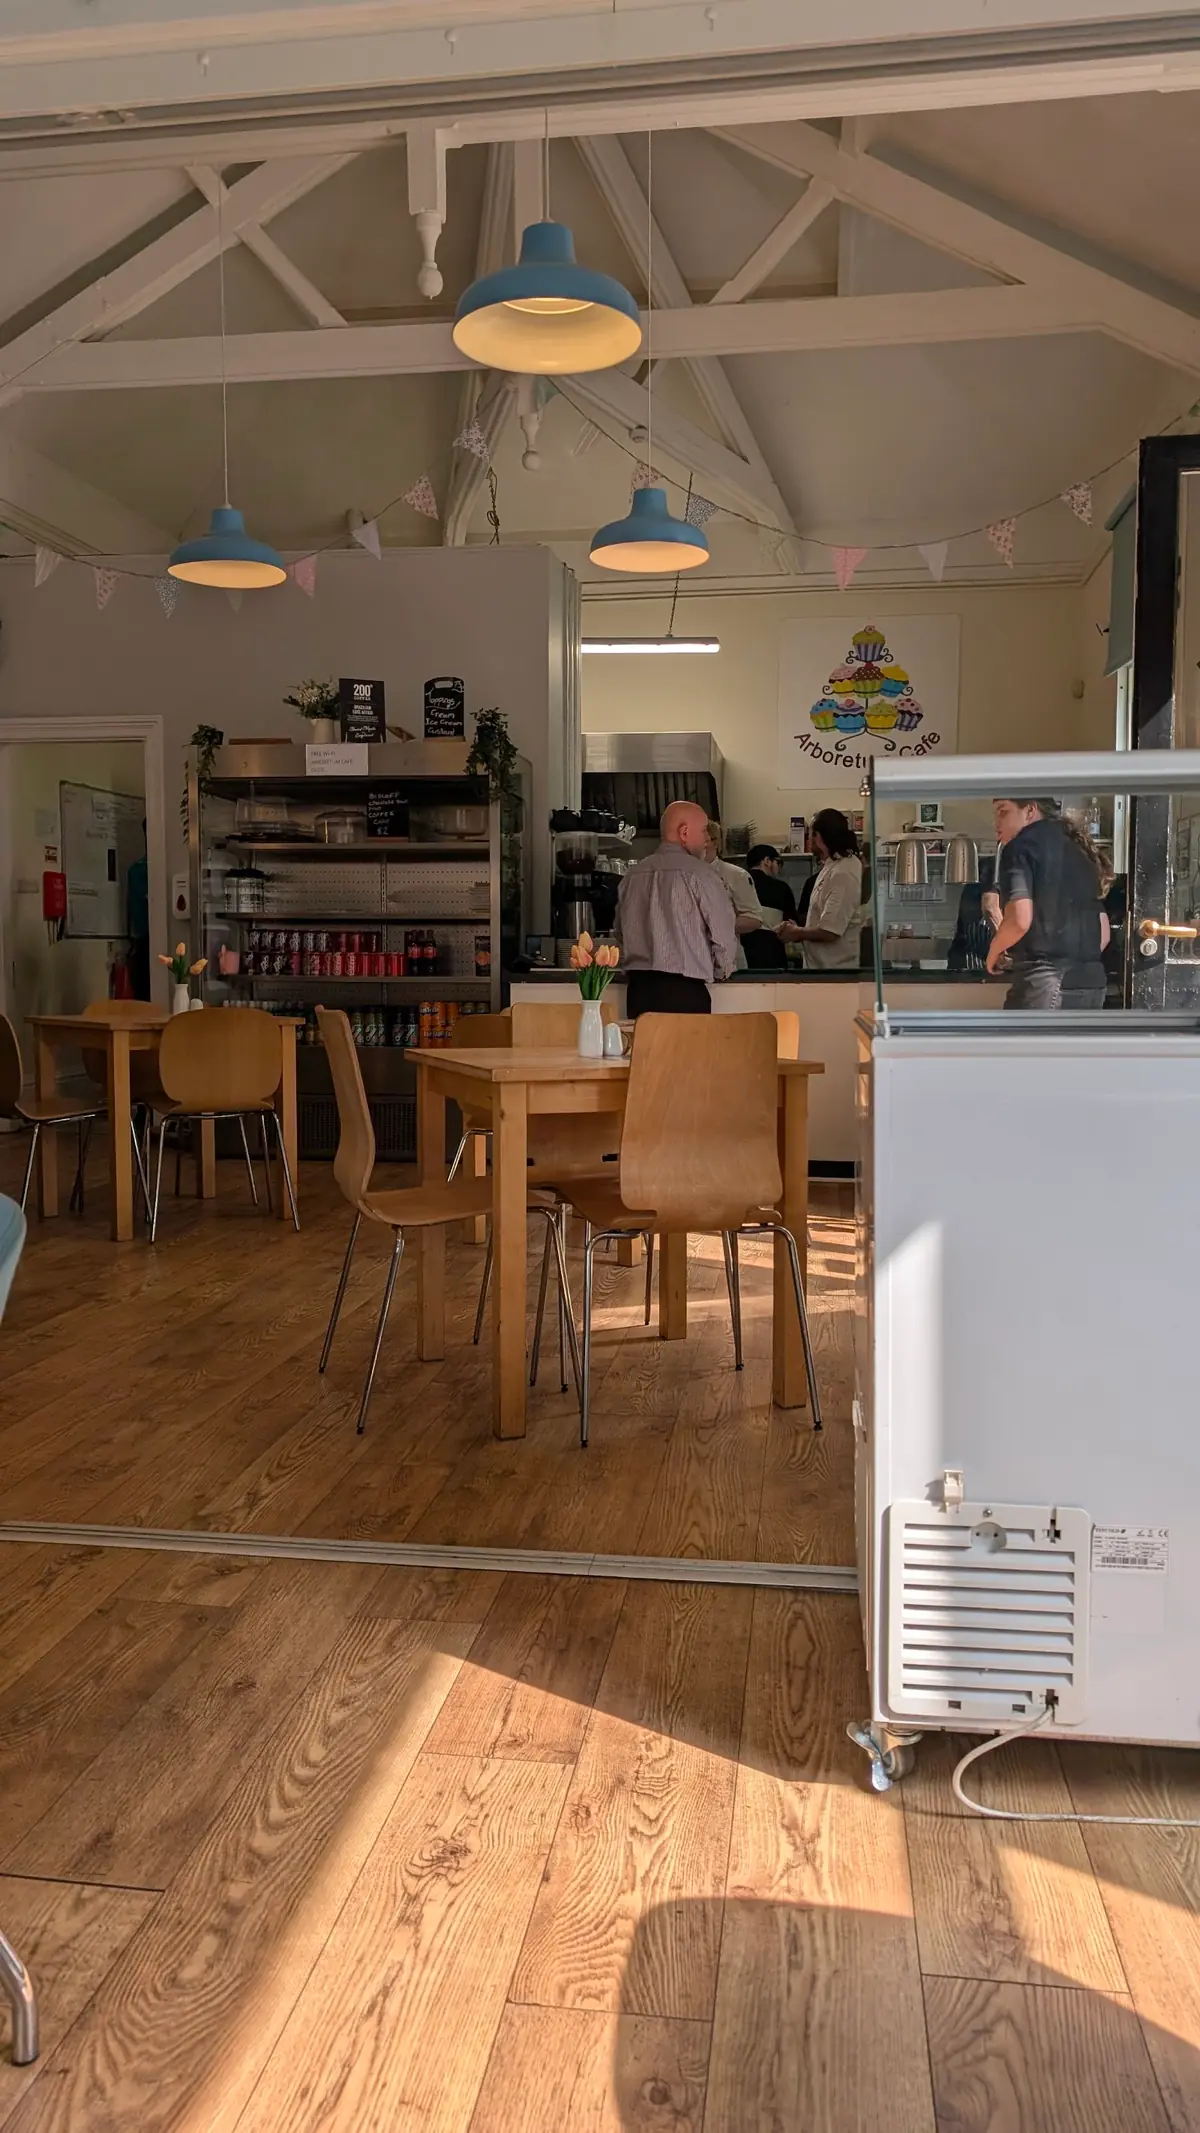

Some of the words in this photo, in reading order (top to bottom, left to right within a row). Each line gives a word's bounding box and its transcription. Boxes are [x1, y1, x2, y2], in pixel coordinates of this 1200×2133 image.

[430, 709, 455, 719] Cream
[425, 717, 439, 725] Ice
[427, 726, 455, 736] Custard
[794, 732, 870, 769] Arboret
[899, 731, 941, 757] Cafe
[376, 826, 389, 836] £2
